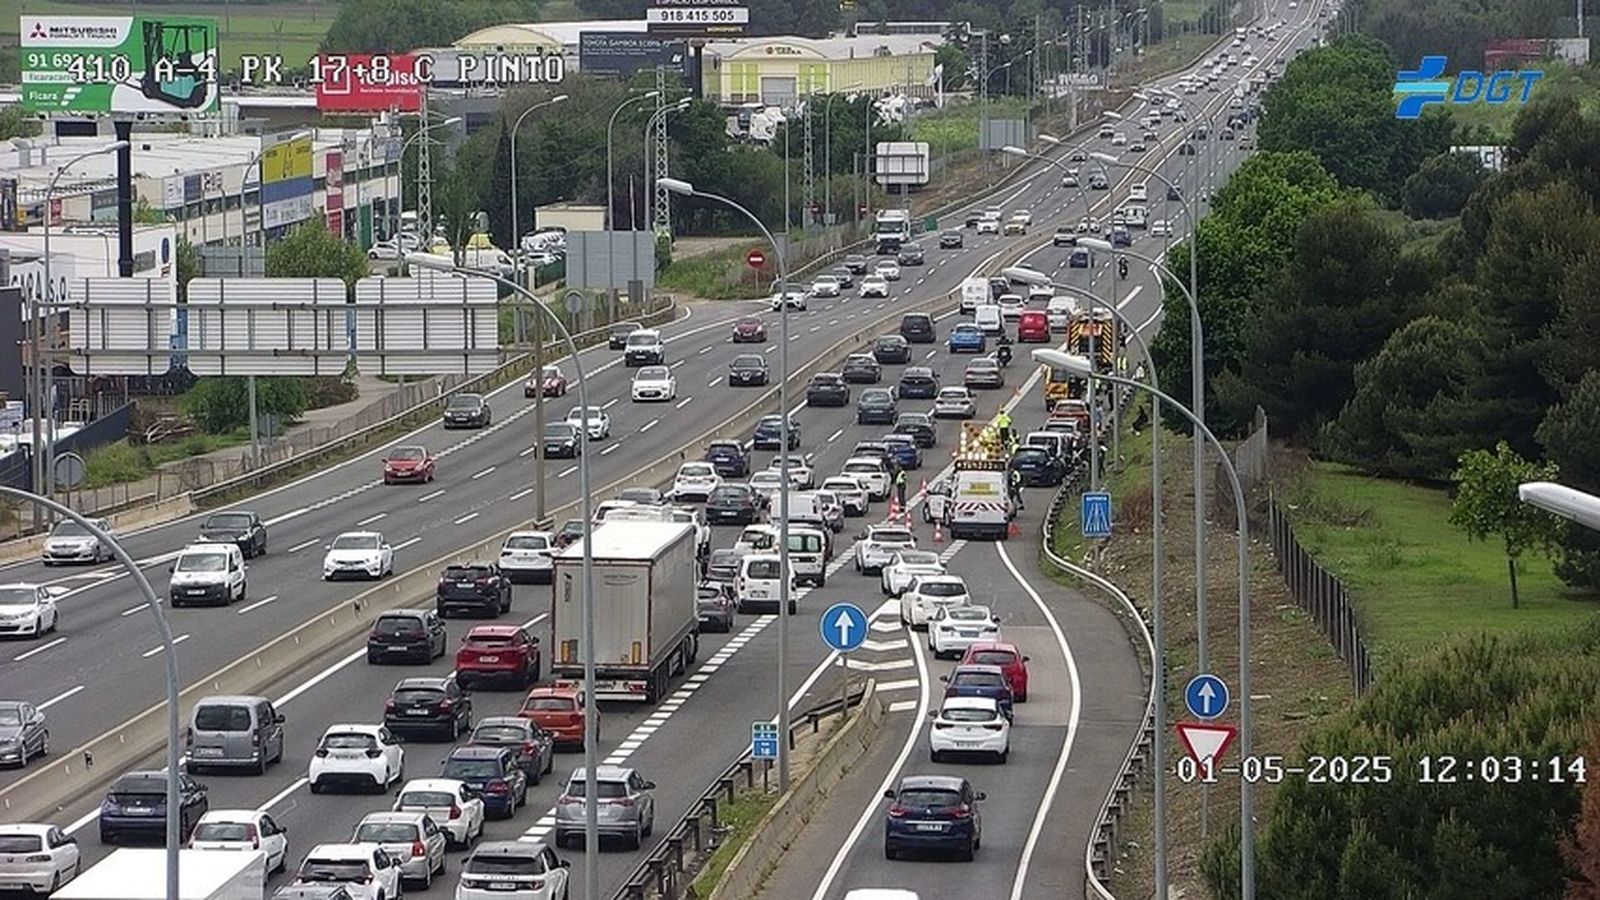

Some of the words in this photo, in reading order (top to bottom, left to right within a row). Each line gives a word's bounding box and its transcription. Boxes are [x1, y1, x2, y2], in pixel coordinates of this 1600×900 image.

[661, 11, 683, 21] 918
[686, 11, 709, 21] 415
[712, 11, 735, 21] 505
[28, 54, 48, 68] 91
